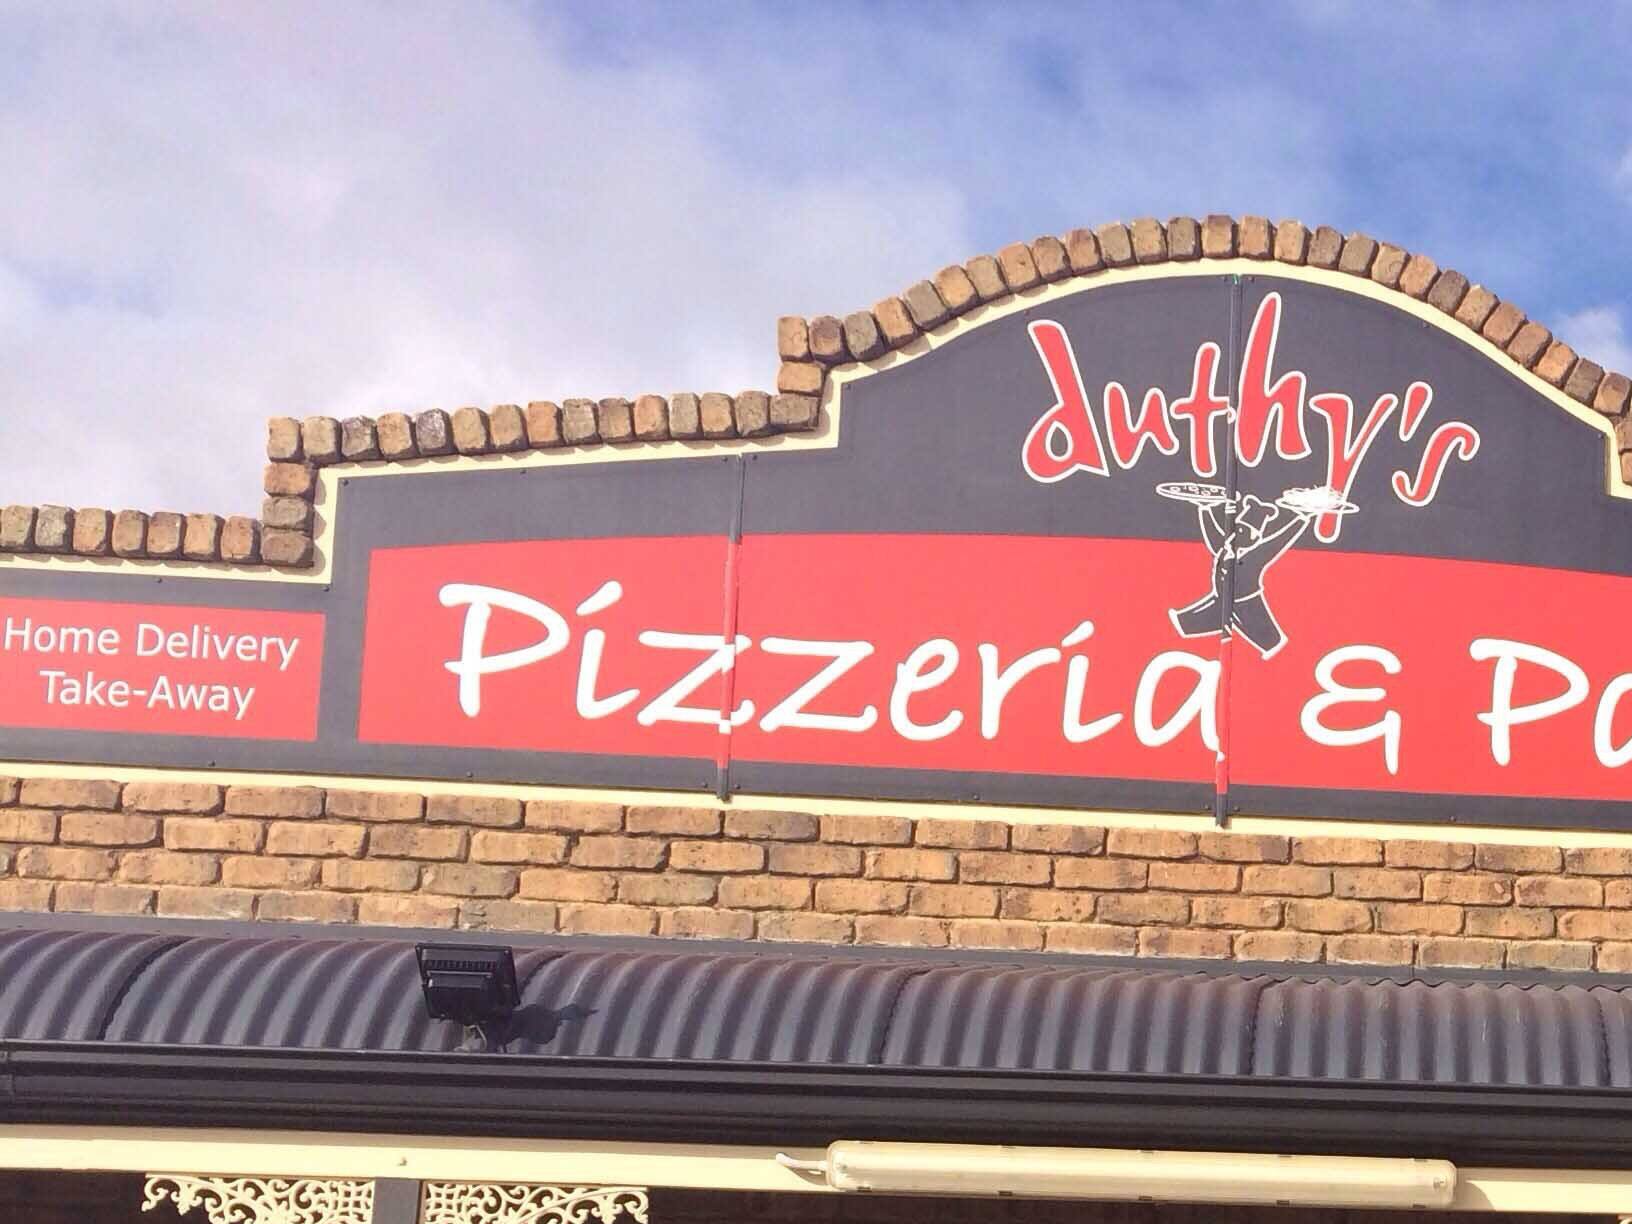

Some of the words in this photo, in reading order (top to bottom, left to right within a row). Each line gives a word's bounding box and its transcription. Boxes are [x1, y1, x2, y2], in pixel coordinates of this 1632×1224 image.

[1022, 292, 1480, 544] duthy's
[3, 618, 119, 656] Home
[136, 623, 299, 671] Delivery
[39, 670, 255, 720] Take-Away
[1299, 644, 1402, 776] &
